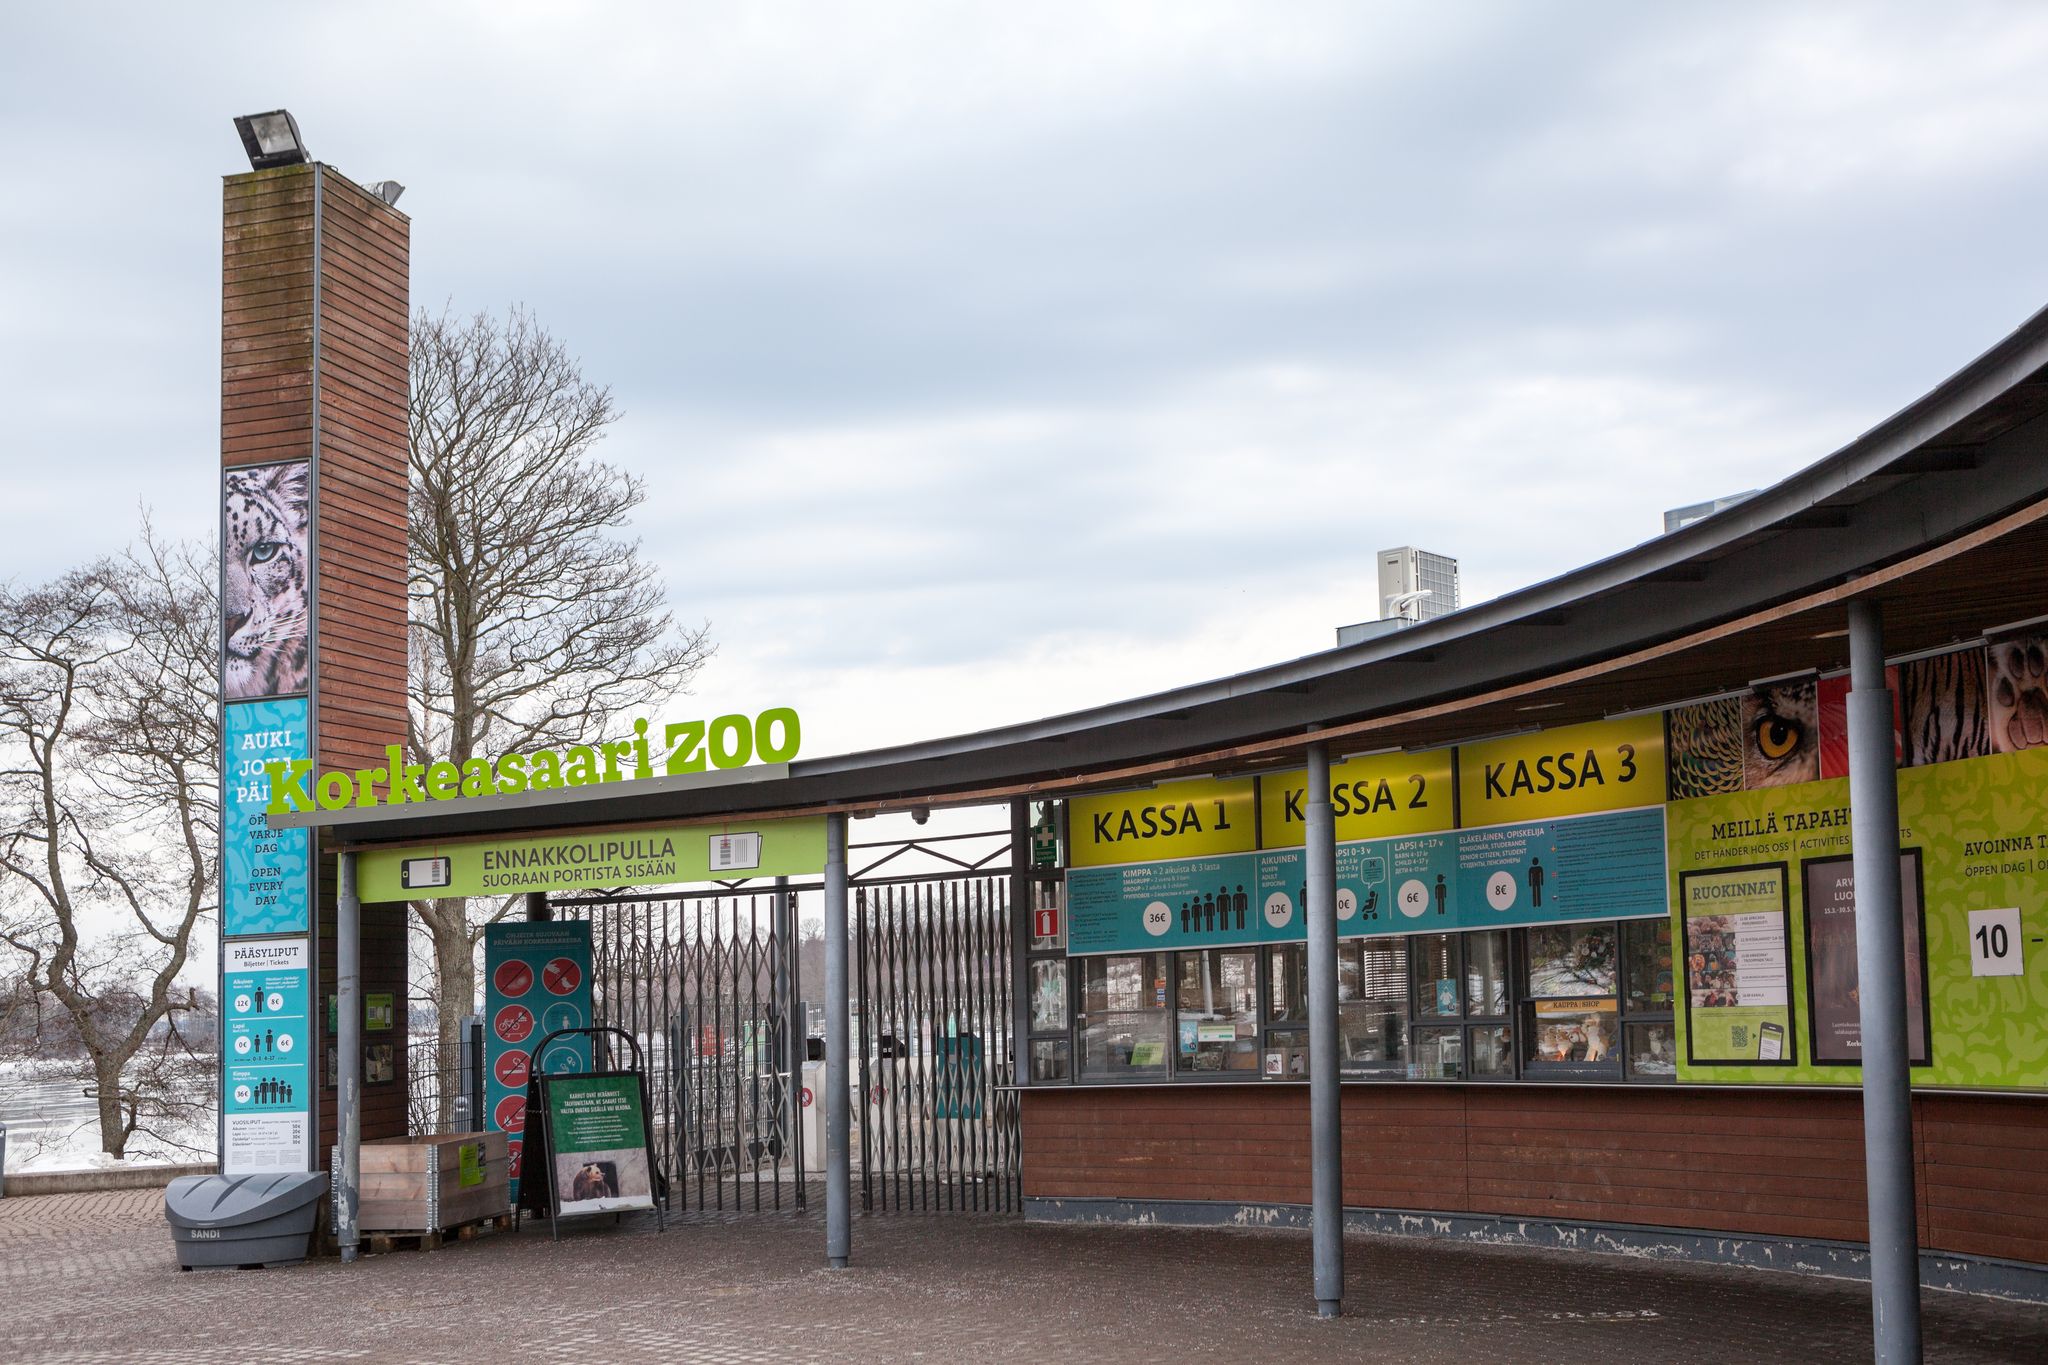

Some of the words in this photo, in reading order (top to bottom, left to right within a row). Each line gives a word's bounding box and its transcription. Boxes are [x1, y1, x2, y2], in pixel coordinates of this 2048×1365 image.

[241, 730, 292, 750] AUKI
[265, 717, 654, 815] Korkeasaari
[665, 707, 801, 775] ZOO
[1484, 748, 1605, 800] KASSA
[1617, 743, 1637, 783] 3
[1284, 778, 1397, 823] KSSA
[1408, 773, 1428, 809] 2
[1093, 801, 1203, 844] KASSA
[1213, 798, 1232, 831] 1
[1711, 812, 1779, 841] MEILLÄ
[249, 829, 284, 840] VARJE
[1506, 828, 1545, 839] OPISKELIJA
[255, 844, 278, 854] DAG
[1394, 842, 1417, 851] LAPSI
[1694, 851, 1710, 861] DET
[1712, 846, 1749, 859] HÄNDER
[1750, 843, 1770, 855] HOS
[1771, 841, 1789, 852] OSS
[1799, 835, 1850, 849] ACTIVITIES
[1964, 836, 2034, 857] AVOINNA
[2037, 834, 2048, 849] T
[483, 837, 676, 870] ENNAKKOLIPULLA
[1502, 848, 1527, 857] STUDENT
[1261, 854, 1298, 865] AIKUINEN
[251, 867, 281, 877] OPEN
[482, 870, 550, 888] SUORAAN
[553, 866, 622, 883] PORTISTA
[625, 860, 676, 878] SISÄÄN
[1122, 868, 1152, 878] KIMPPA
[1164, 865, 1190, 874] aikuista
[1965, 865, 1998, 878] ÖPPEN
[2001, 862, 2025, 874] IDAG
[2037, 860, 2048, 871] O
[249, 881, 284, 892] EVERY
[1835, 877, 1854, 888] ARV
[1495, 884, 1507, 896] 8€
[1692, 880, 1777, 900] RUOKINNAT
[1834, 891, 1856, 901] LUO
[255, 896, 278, 906] DAY
[1406, 892, 1419, 903] 6€
[1270, 904, 1286, 914] 12€
[1338, 899, 1350, 909] 0€
[1149, 913, 1166, 923] 36€
[1975, 924, 2009, 959] 10
[234, 946, 299, 959] PÄÄSYLIPUT
